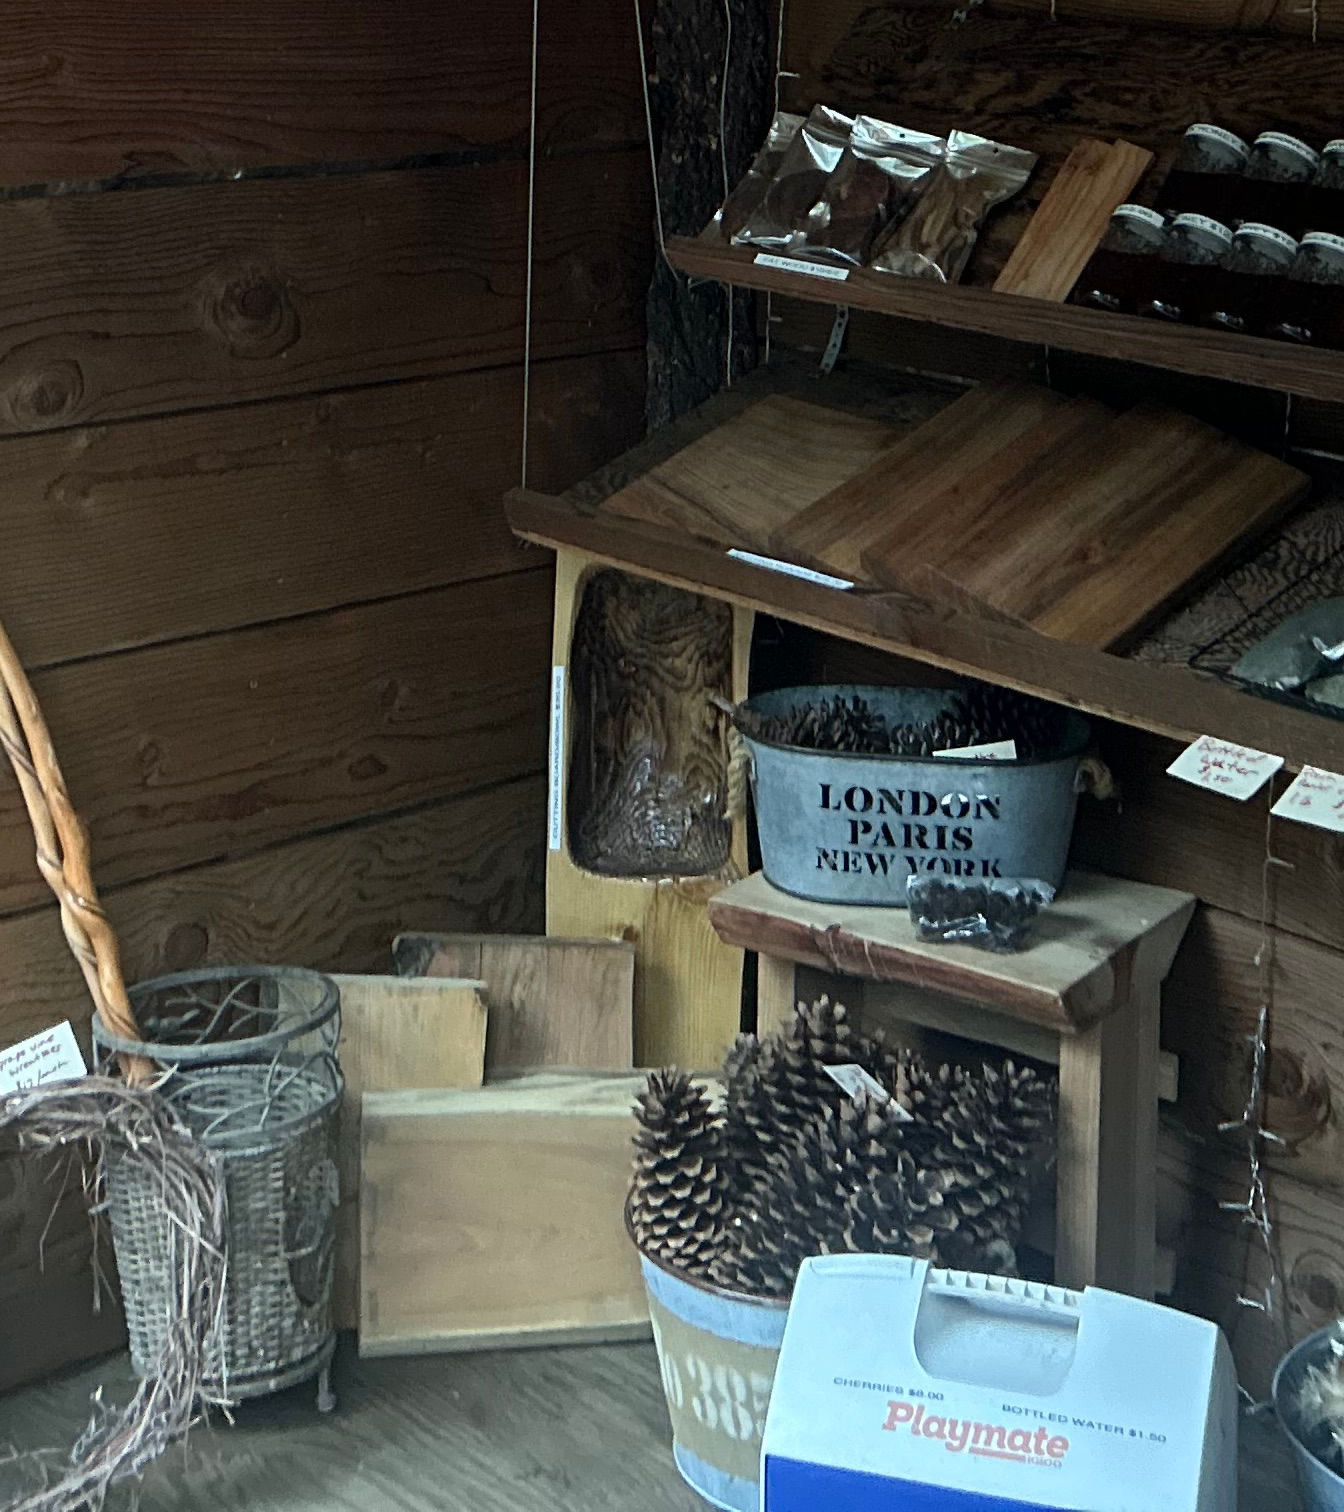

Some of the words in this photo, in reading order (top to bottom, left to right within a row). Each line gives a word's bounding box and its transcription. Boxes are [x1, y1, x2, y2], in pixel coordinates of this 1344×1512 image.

[819, 783, 1001, 820] LONDON
[848, 819, 973, 851] PARIS
[815, 846, 896, 876] NEW
[905, 855, 1002, 878] YORK
[833, 1377, 905, 1395] CHERRIES
[881, 1399, 1070, 1458] Playmate
[1001, 1403, 1069, 1424] BOTTLED
[1072, 1416, 1125, 1436] WATER
